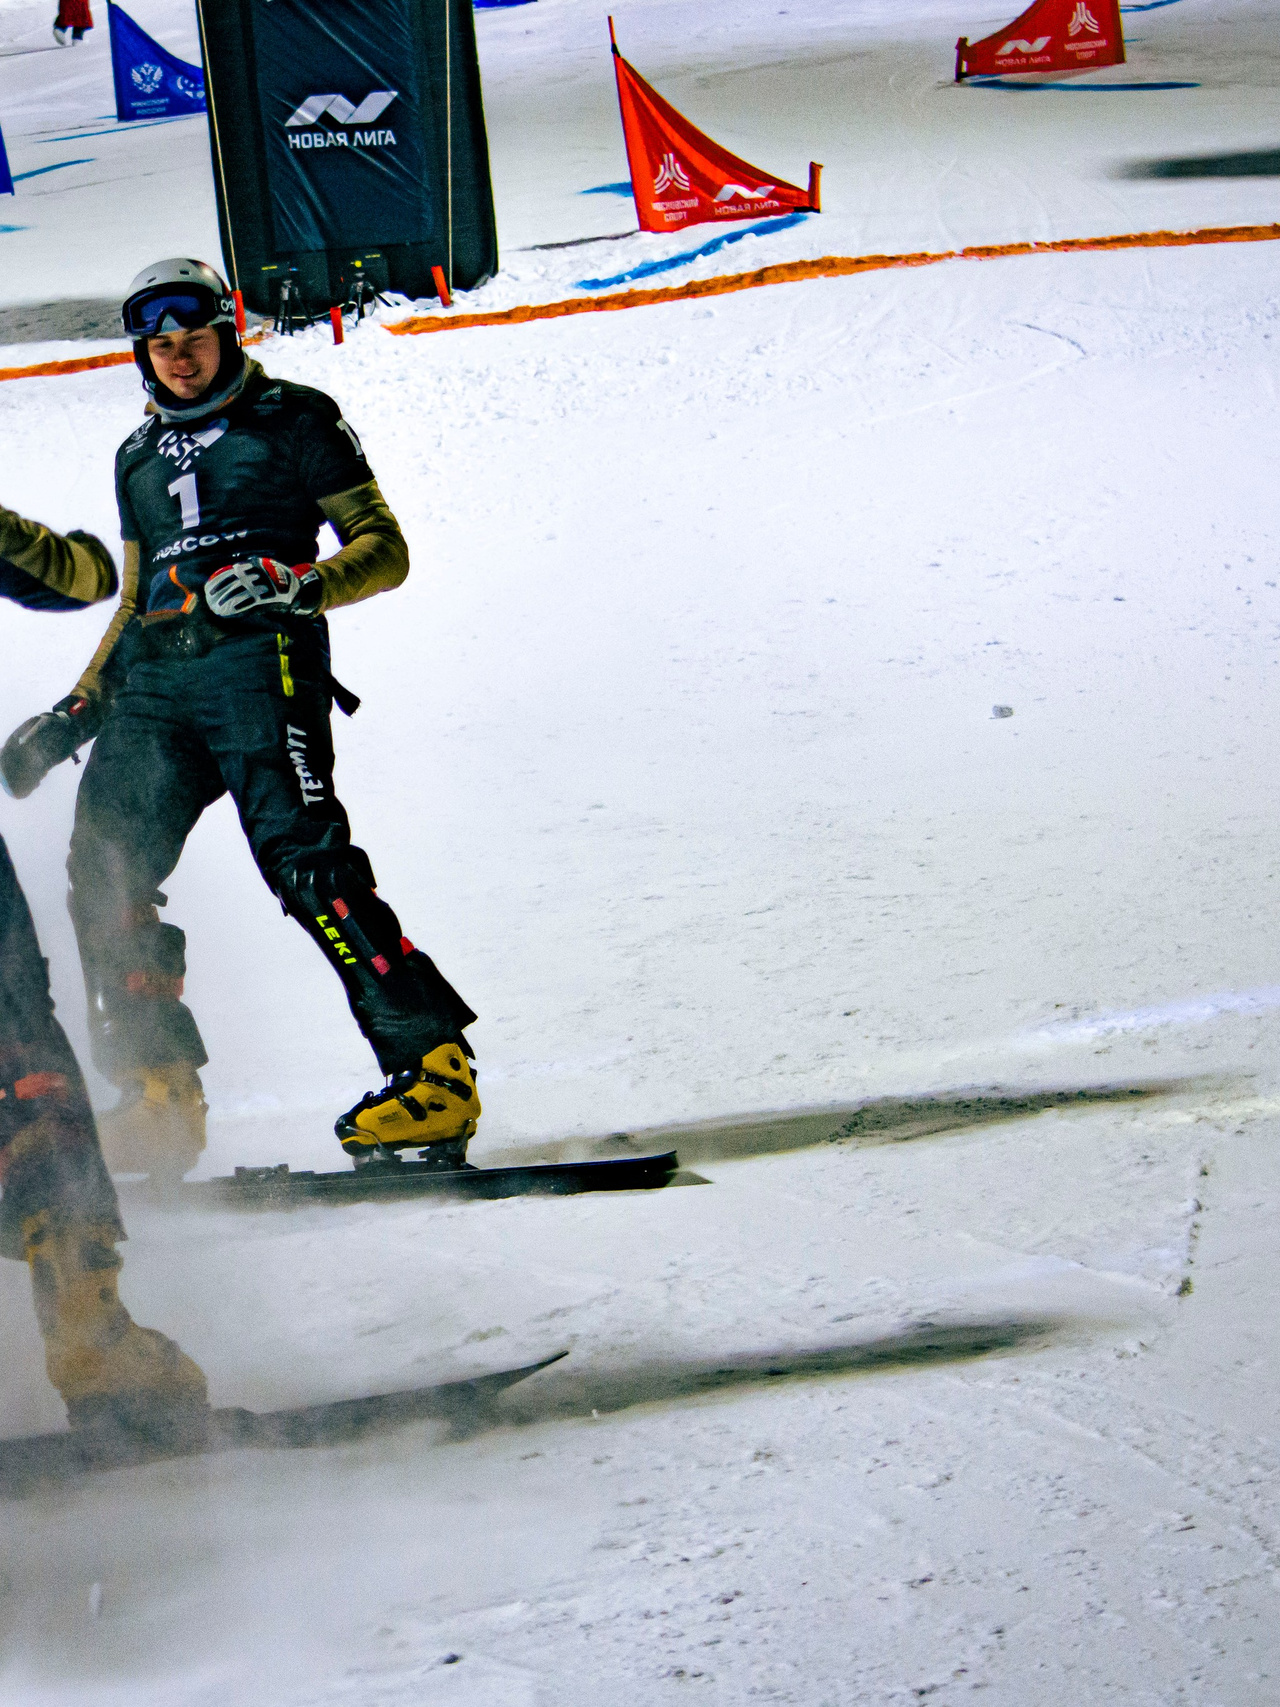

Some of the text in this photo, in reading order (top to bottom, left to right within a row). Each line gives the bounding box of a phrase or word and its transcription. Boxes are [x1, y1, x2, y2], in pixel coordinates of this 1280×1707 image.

[287, 129, 397, 149] НОВАЯ ЛИГА
[714, 199, 780, 215] НОВАЯ ЛИГА
[168, 472, 200, 529] 1
[315, 914, 357, 965] LEKI
